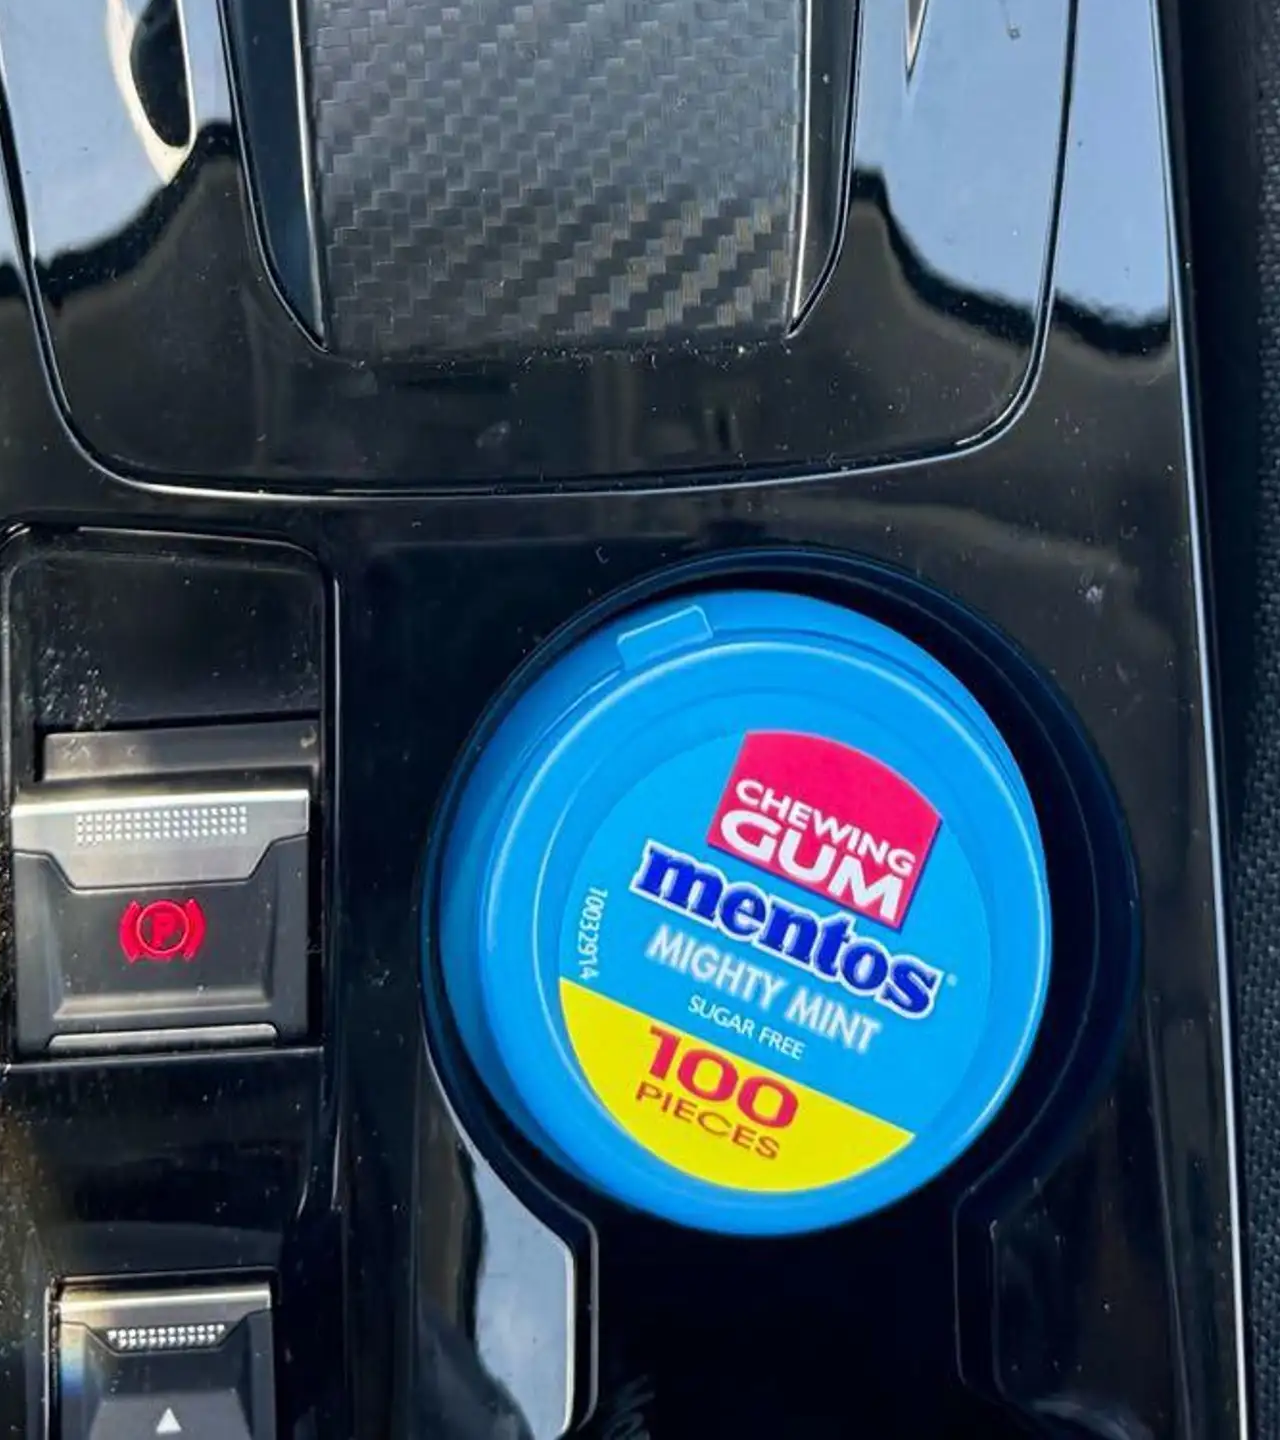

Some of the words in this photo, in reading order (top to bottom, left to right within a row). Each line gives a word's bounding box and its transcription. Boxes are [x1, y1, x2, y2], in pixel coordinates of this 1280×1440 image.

[721, 810, 903, 921] GUM
[735, 779, 916, 877] CHEWING
[577, 886, 609, 980] 10032914
[629, 840, 945, 1019] mentos
[645, 923, 787, 1011] MIGHTY
[783, 987, 883, 1054] MINT
[687, 994, 757, 1040] SUGAR
[758, 1025, 806, 1060] FREE
[634, 1080, 781, 1162] PIECES
[648, 1024, 799, 1130] 100
